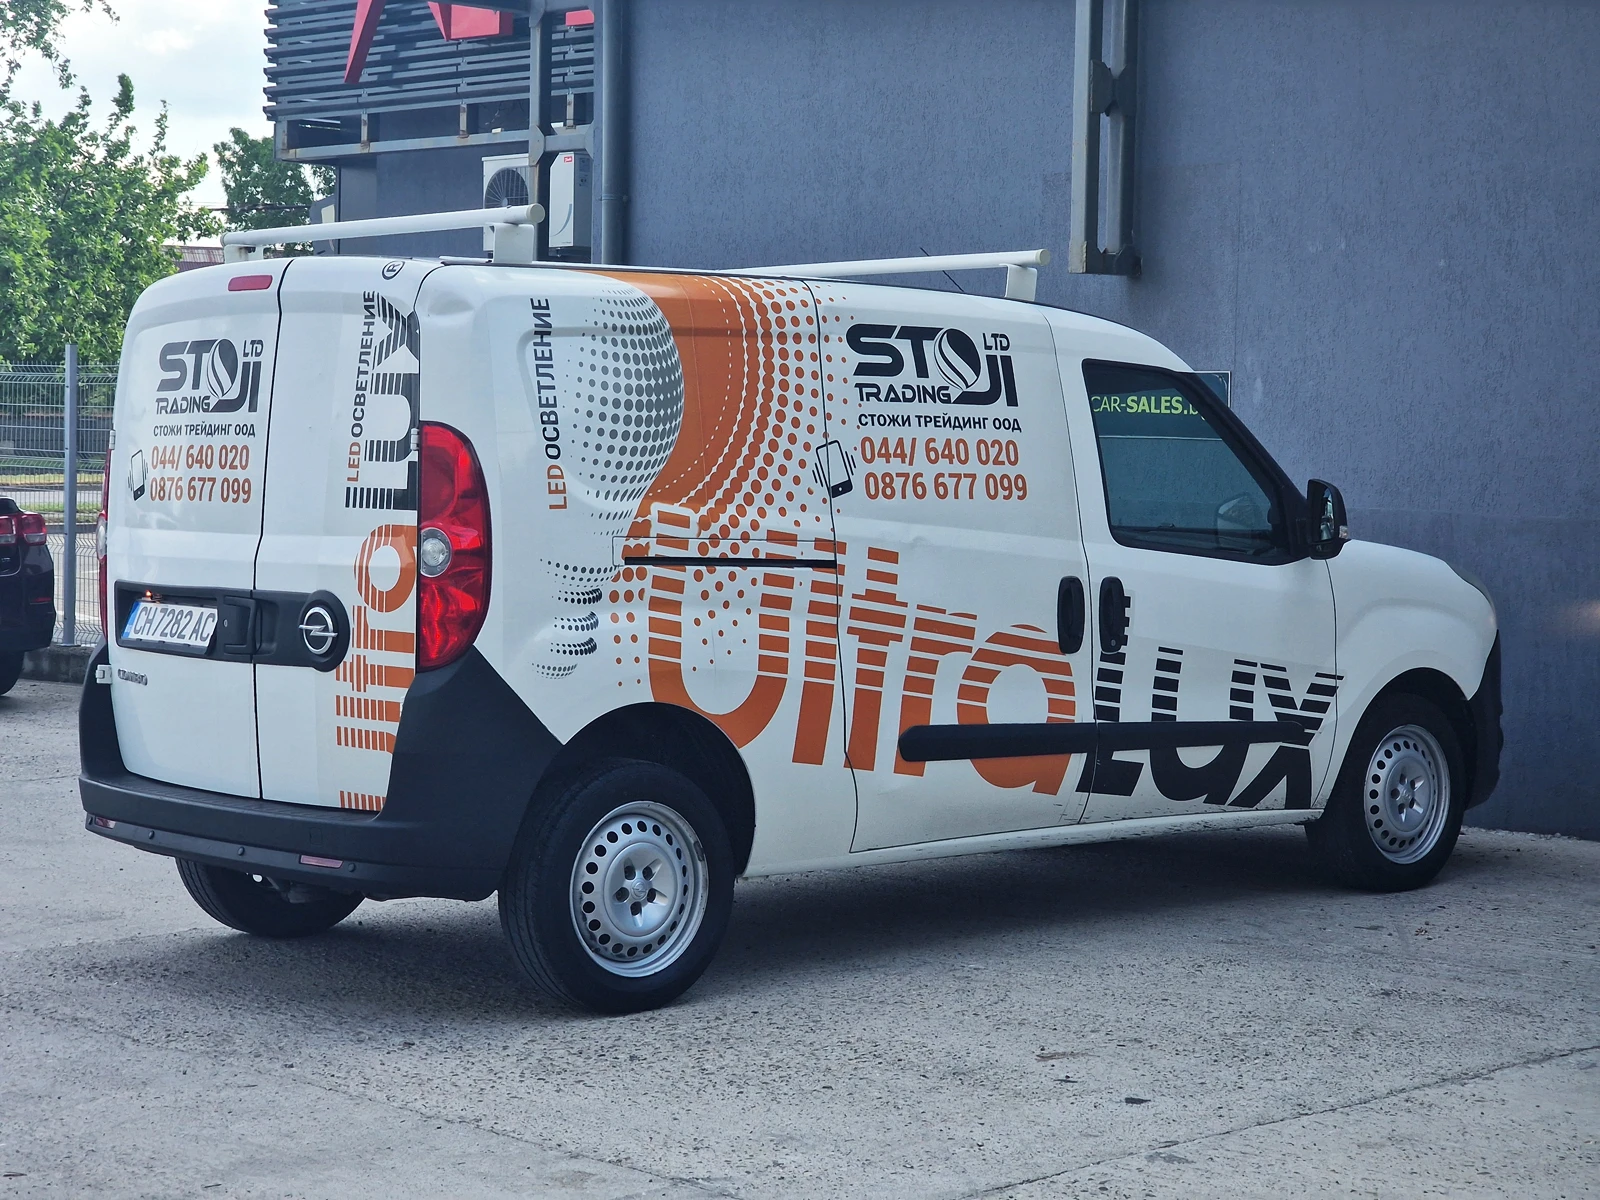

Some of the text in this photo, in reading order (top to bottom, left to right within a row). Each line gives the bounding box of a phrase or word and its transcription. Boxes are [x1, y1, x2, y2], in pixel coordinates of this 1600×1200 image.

[243, 340, 263, 357] LTD
[983, 333, 1010, 351] LTD
[347, 290, 375, 482] LED ОСВЕТЛЕНИЕ
[854, 383, 951, 403] TRADING
[156, 395, 211, 414] TRADING
[530, 298, 568, 510] LED ОСВЕТЛЕНИЕ
[153, 421, 256, 438] СТОЖИ ТРЕЙДИНГ ООД
[858, 412, 1022, 433] СТОЖИ ТРЕЙДИНГ ООД
[152, 444, 250, 471] 044/ 640 020
[860, 437, 1019, 466] 044/ 640 020
[150, 476, 252, 504] 0876 677 099
[864, 472, 1028, 501] 0876 677 099
[152, 608, 193, 640] 7282
